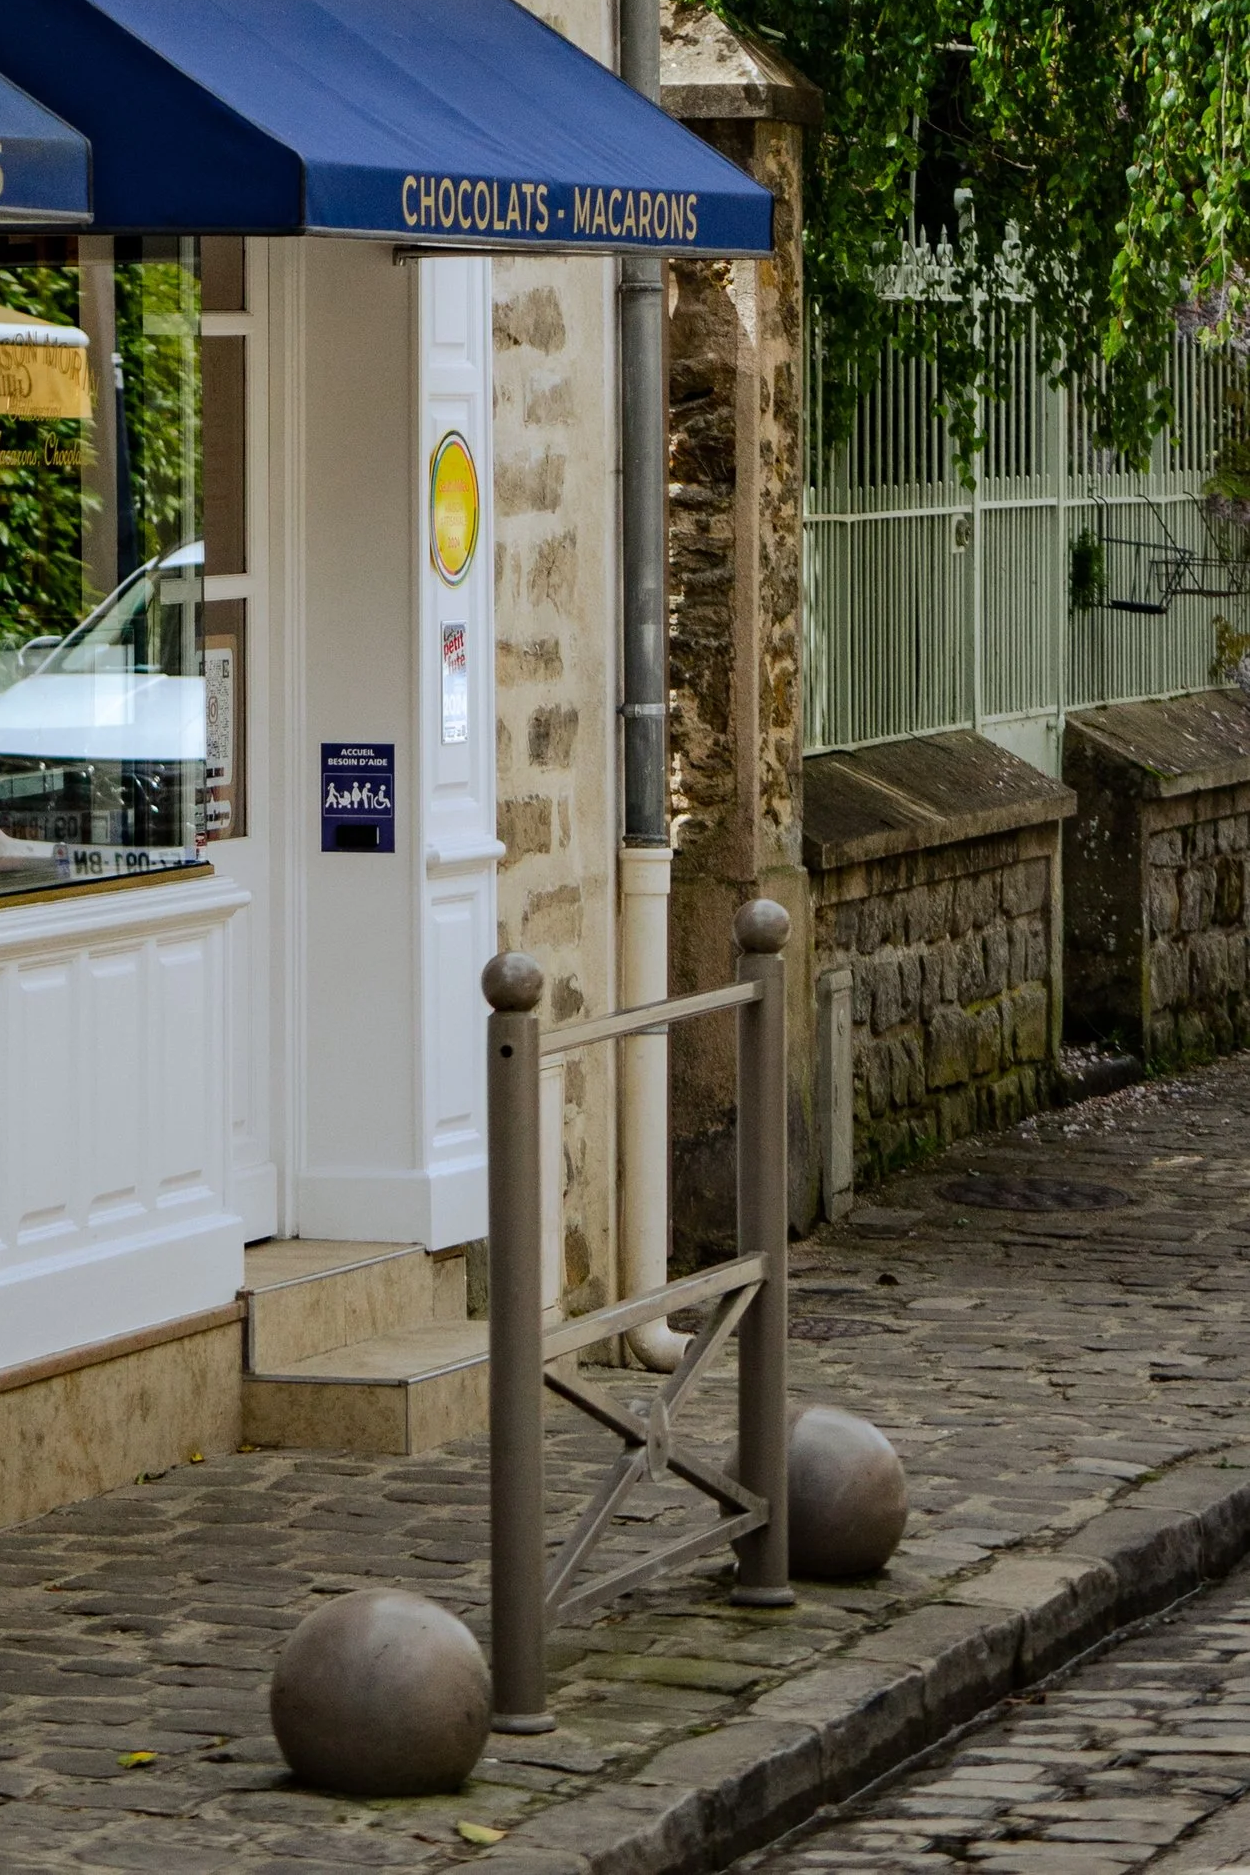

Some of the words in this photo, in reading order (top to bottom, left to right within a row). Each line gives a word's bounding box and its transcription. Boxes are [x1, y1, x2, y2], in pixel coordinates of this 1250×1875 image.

[402, 175, 549, 233] CHOCOLATS
[573, 186, 698, 240] MACARONS
[443, 629, 464, 662] petit
[327, 758, 358, 766] BESOIN
[359, 758, 388, 766] D'AIDE
[340, 748, 375, 756] ACCUEIL
